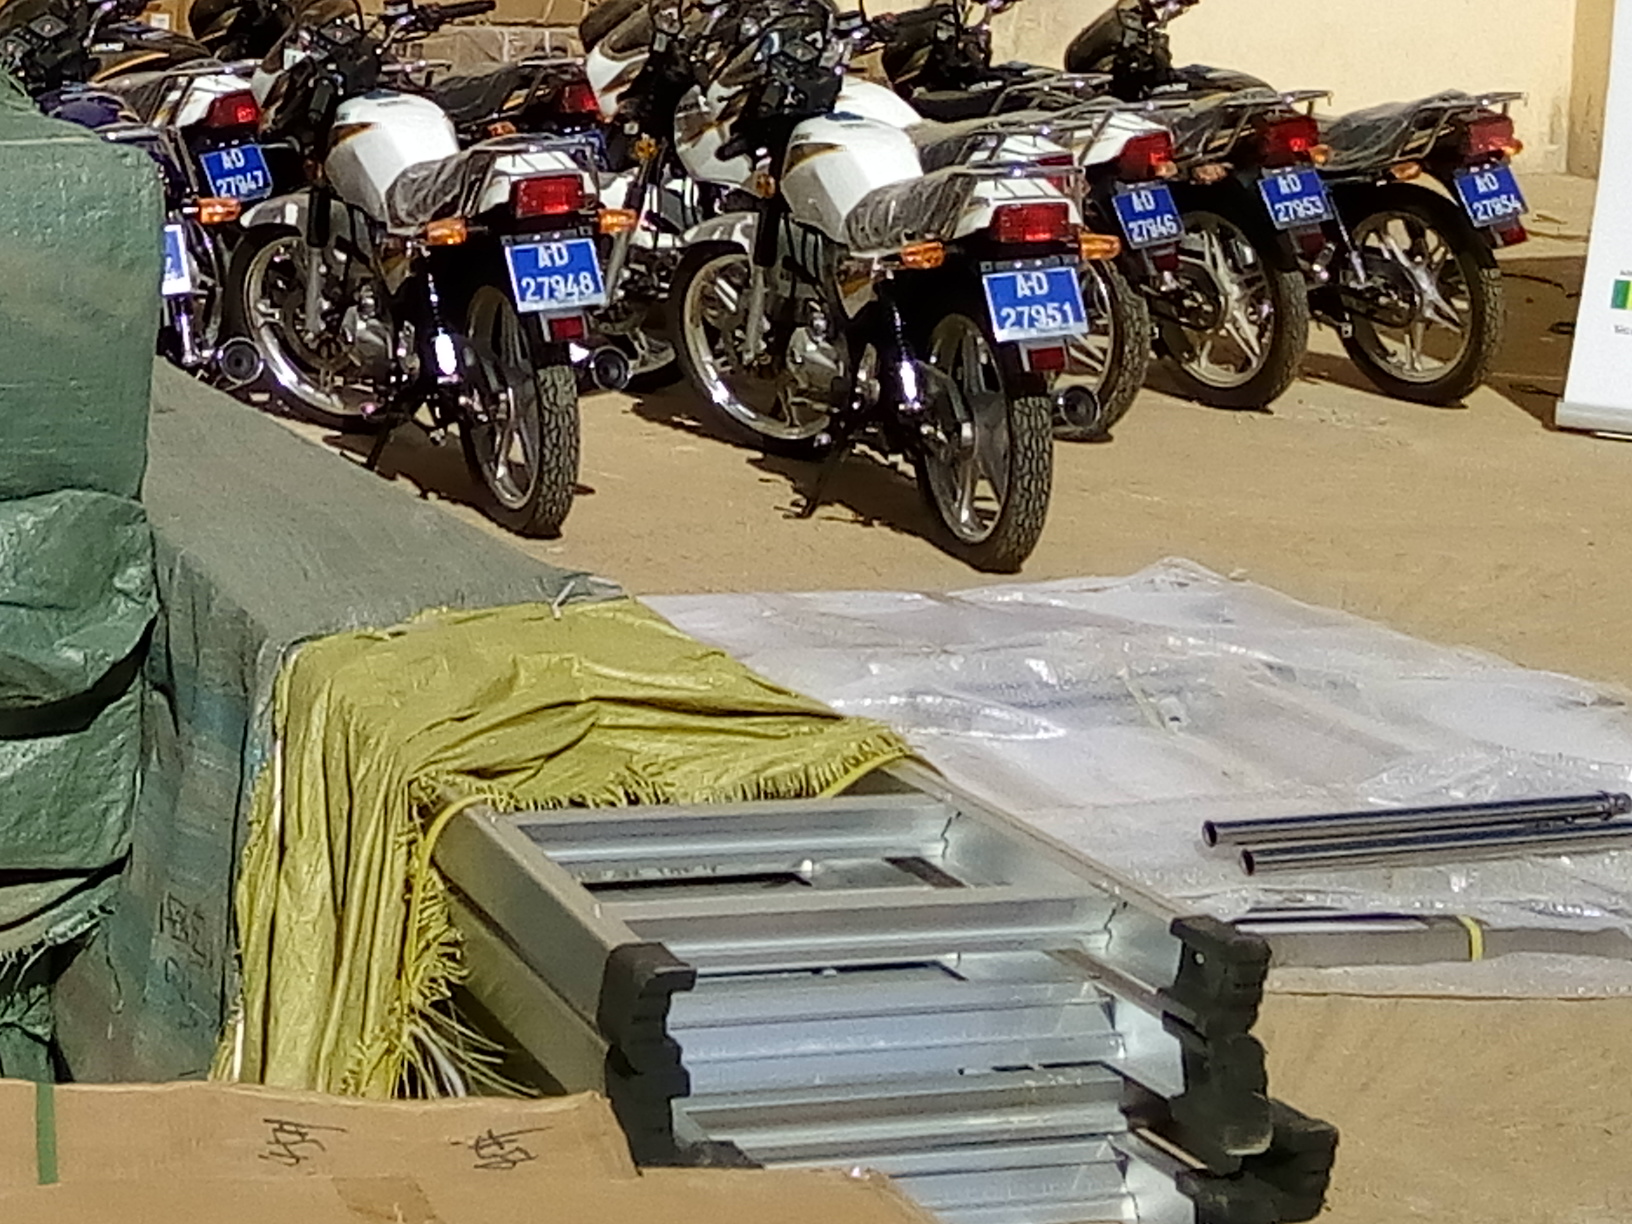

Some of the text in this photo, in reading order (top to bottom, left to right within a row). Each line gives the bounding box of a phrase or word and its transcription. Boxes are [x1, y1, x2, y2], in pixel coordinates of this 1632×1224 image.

[1273, 194, 1325, 222] 27953
[520, 271, 596, 302] 27948
[999, 301, 1075, 330] 27951
